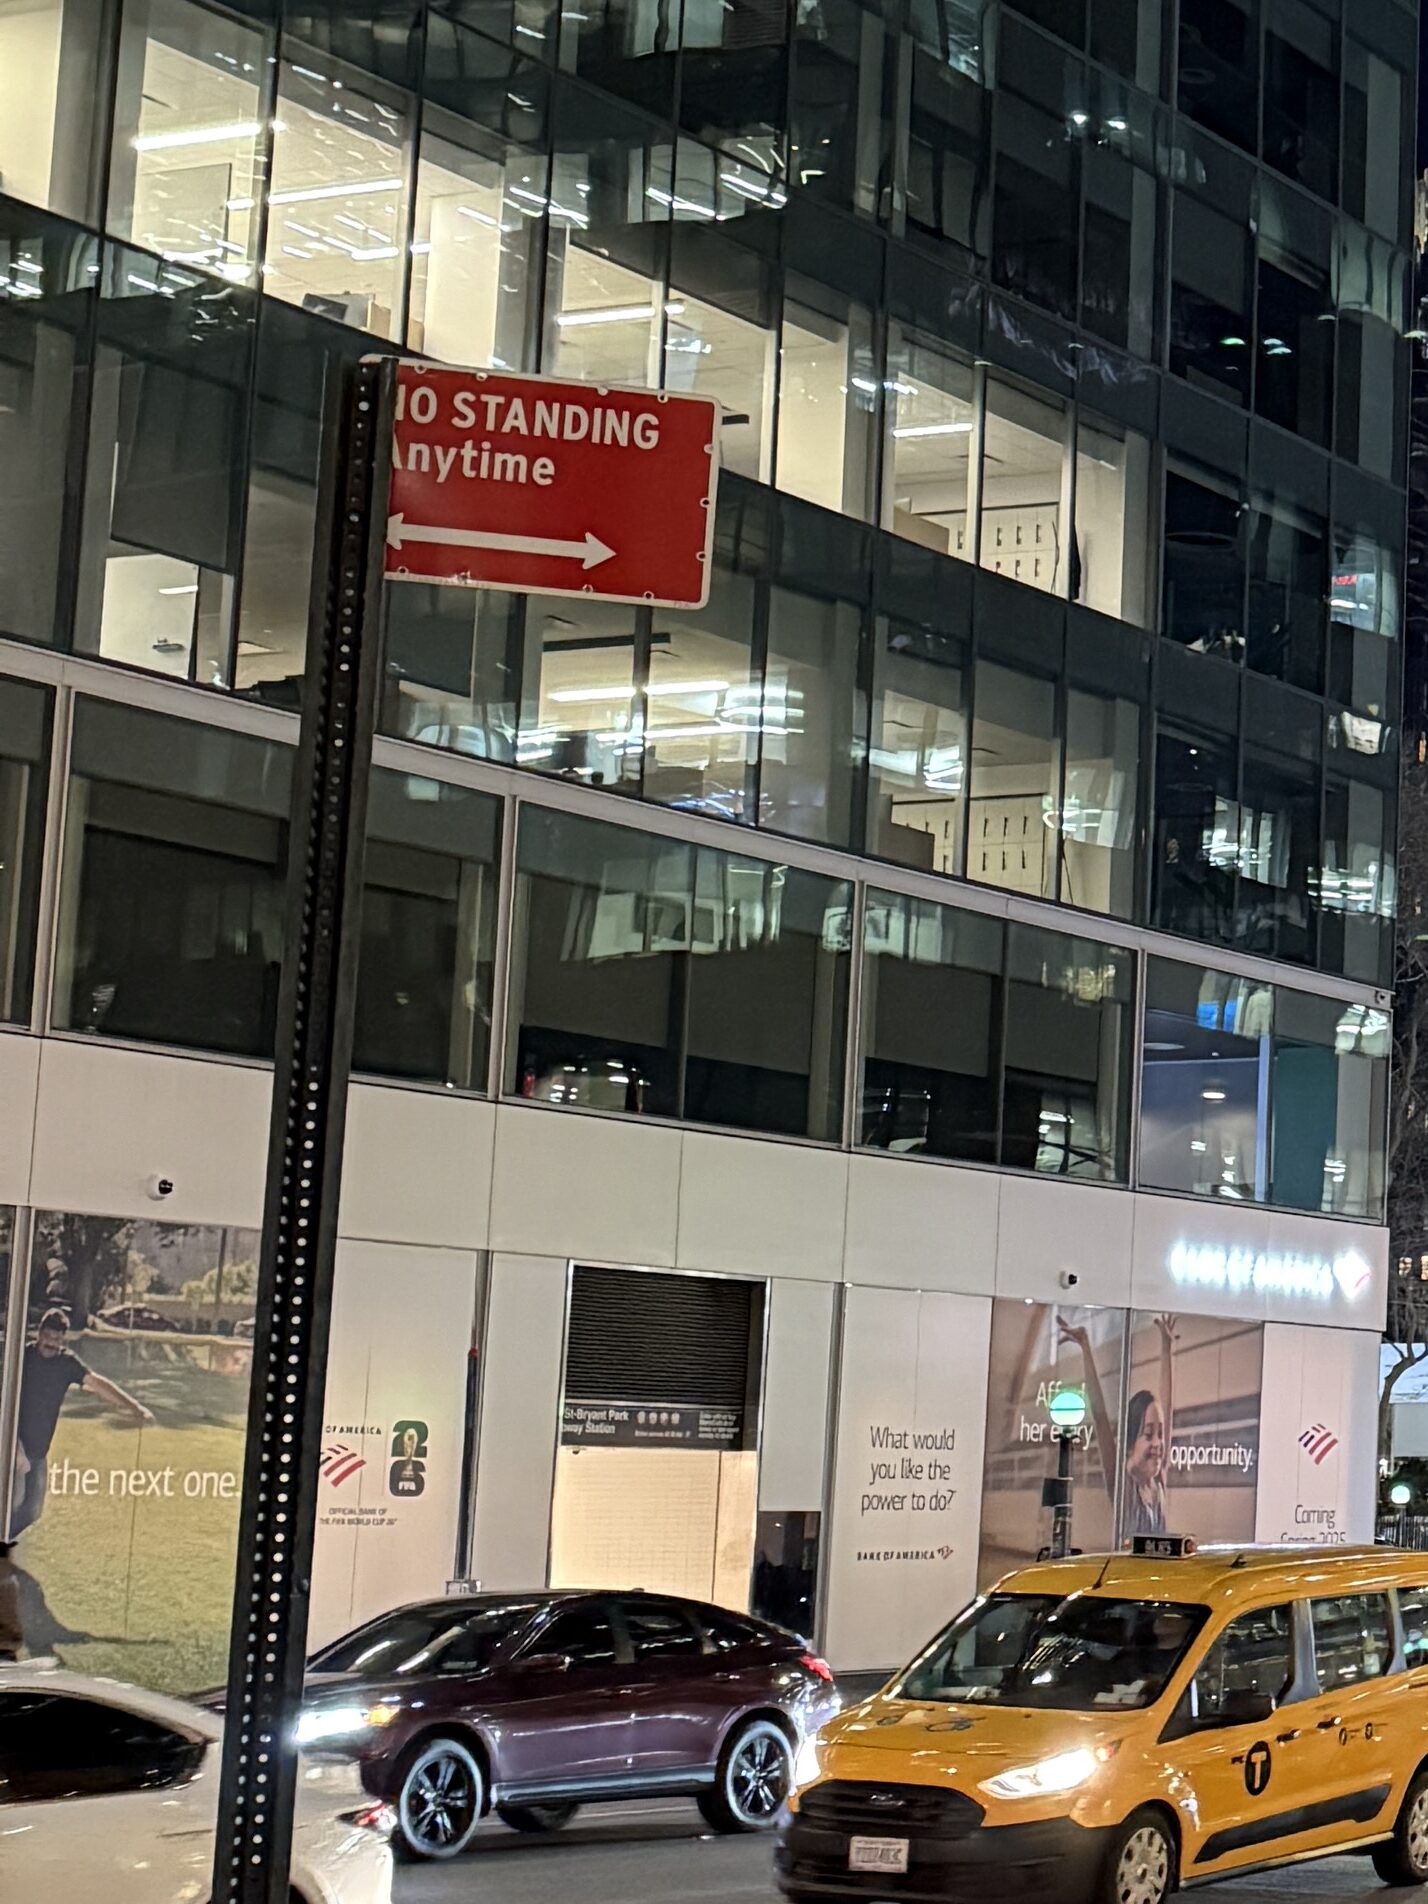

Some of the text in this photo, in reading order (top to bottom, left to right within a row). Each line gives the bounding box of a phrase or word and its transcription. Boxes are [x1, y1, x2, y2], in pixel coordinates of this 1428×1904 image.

[451, 390, 660, 450] STANDING
[585, 1421, 616, 1435] Station
[608, 1408, 630, 1422] Park
[339, 1425, 382, 1435] AMERICA
[870, 1425, 956, 1451] What would
[1020, 1416, 1047, 1443] her
[1170, 1442, 1254, 1473] opportunity.
[50, 1457, 242, 1498] the next one.
[869, 1457, 951, 1486] you like the
[861, 1489, 957, 1517] power to do?
[1294, 1504, 1337, 1530] Coming
[857, 1551, 882, 1562] BANK
[896, 1551, 936, 1561] AMERICA
[1251, 1750, 1267, 1789] T
